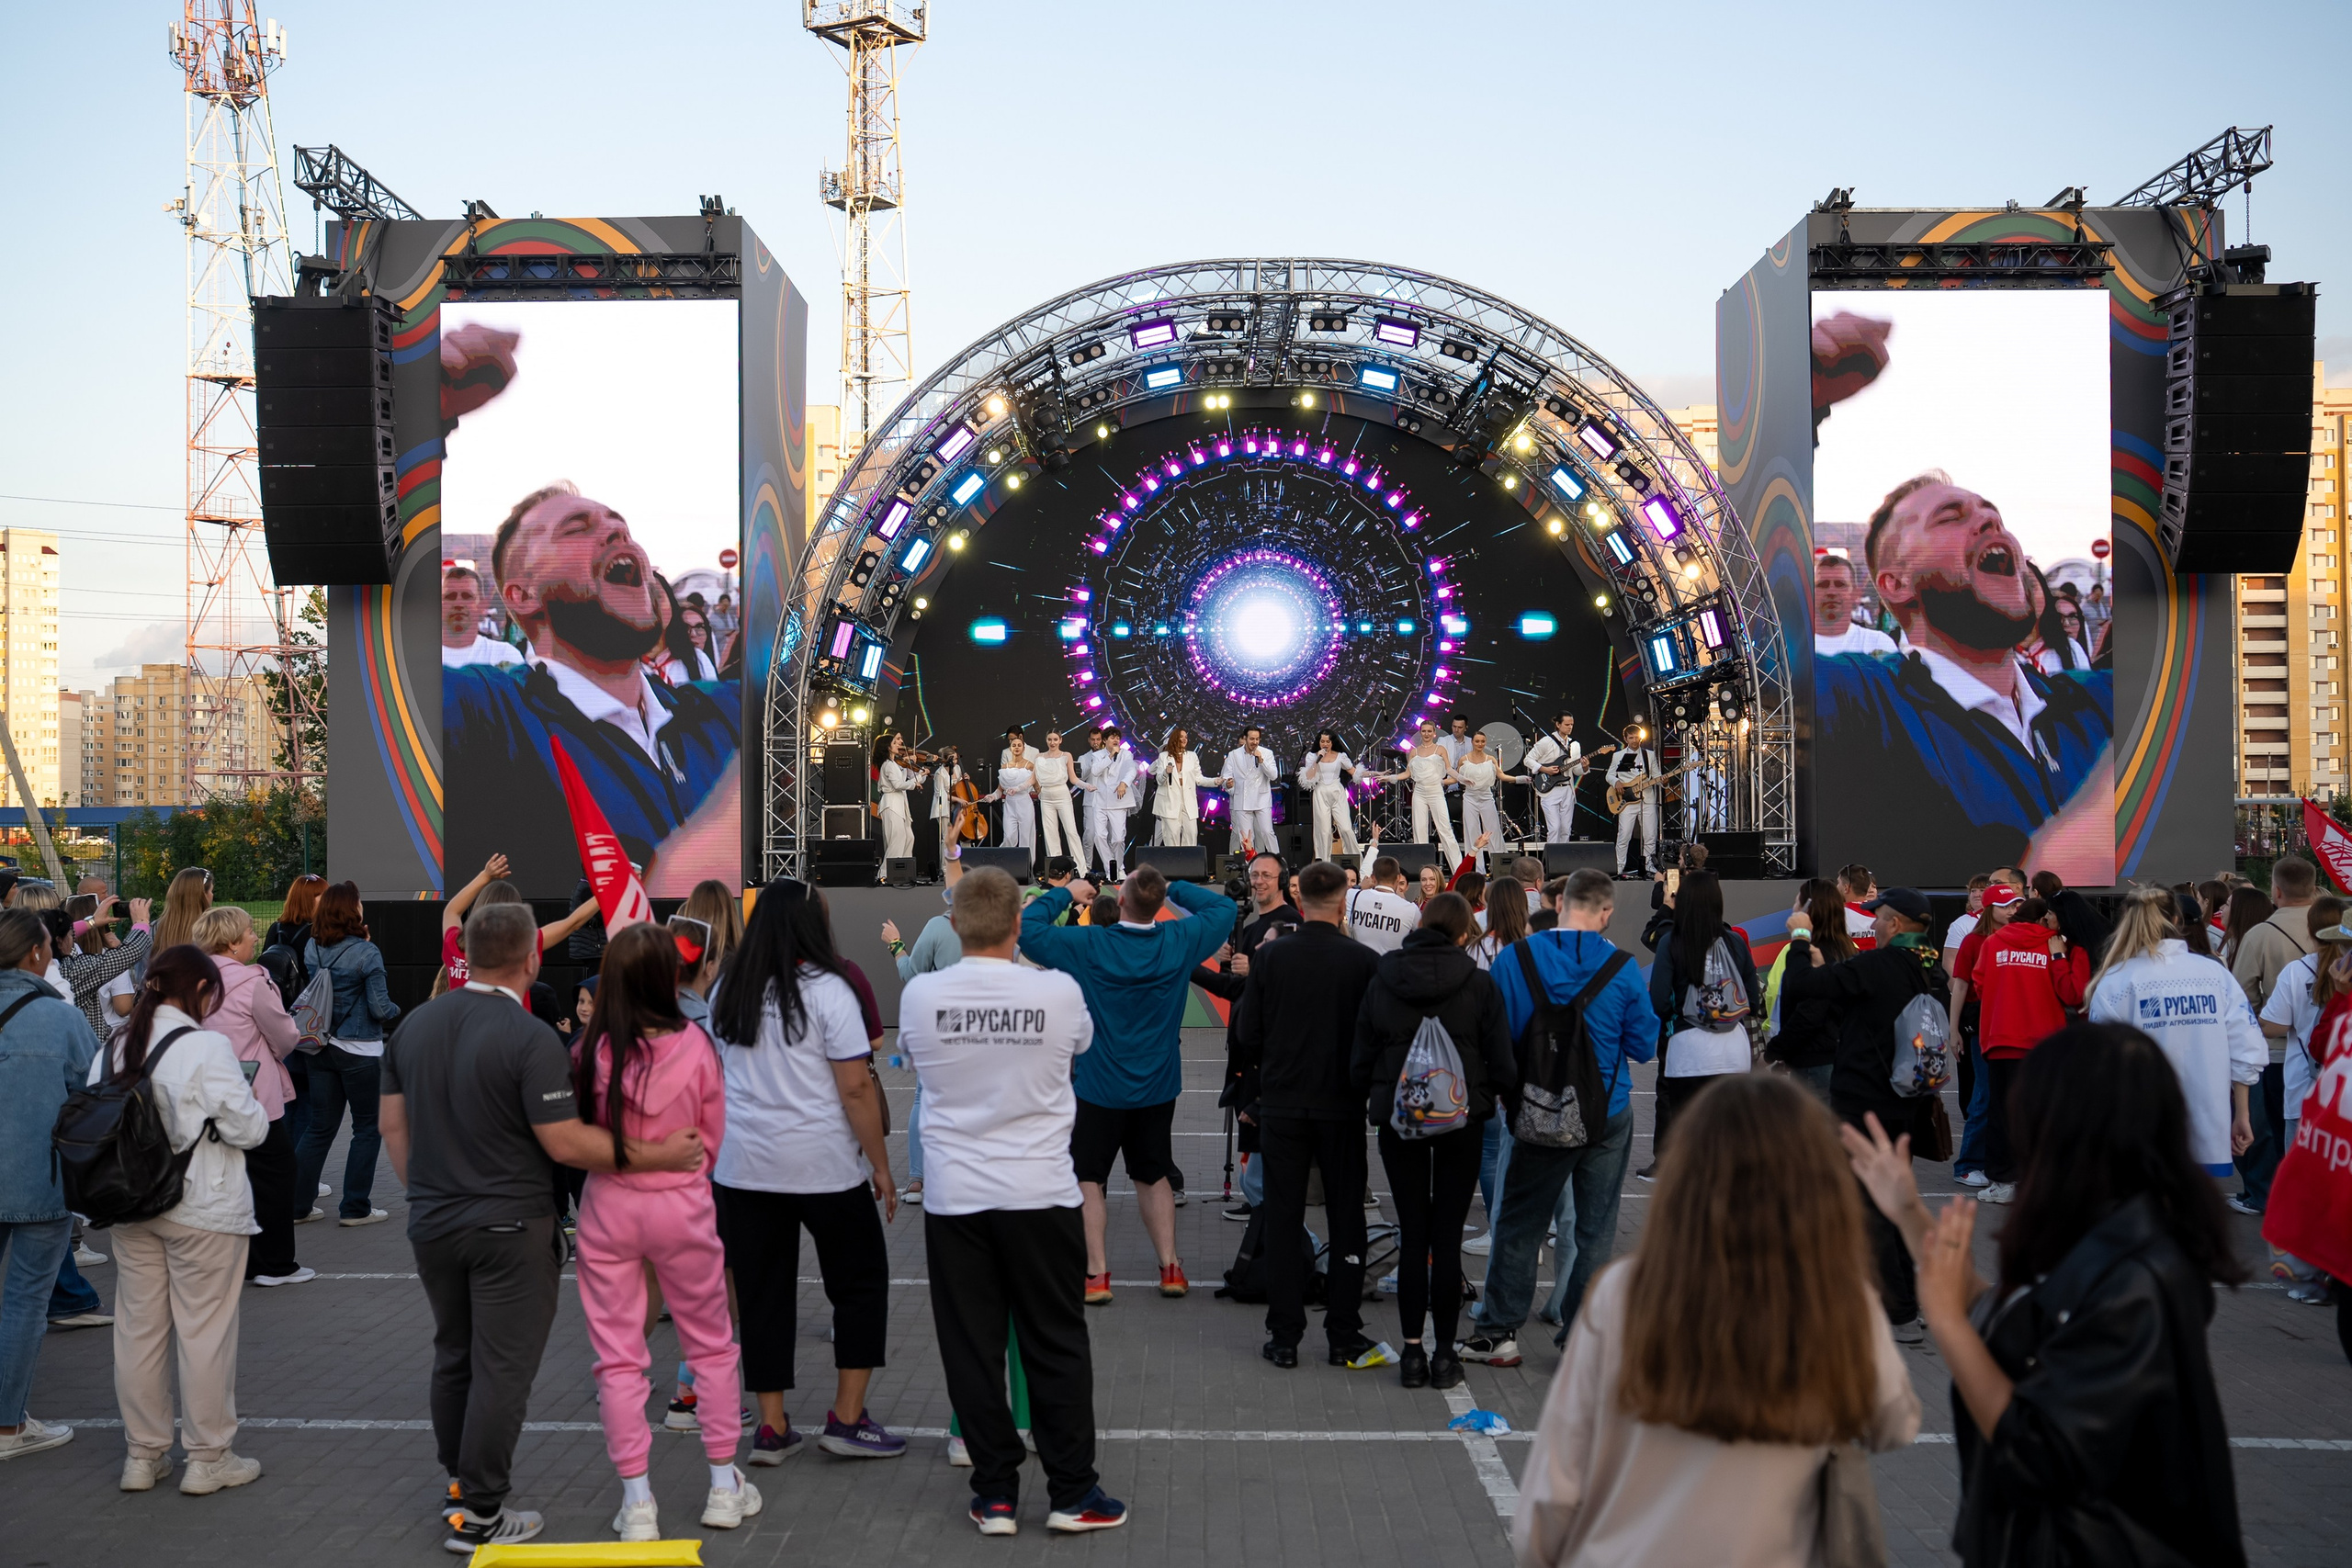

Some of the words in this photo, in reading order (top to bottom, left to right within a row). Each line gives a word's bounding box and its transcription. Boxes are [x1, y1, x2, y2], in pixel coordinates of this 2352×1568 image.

[1351, 910, 1401, 932] РУСАГРО
[2010, 951, 2047, 965] РУСАГРО
[2164, 995, 2217, 1016] РУСАГРО
[967, 1009, 1046, 1032] РУСАГРО
[2143, 1021, 2167, 1030] ЛИДЕР
[2169, 1018, 2218, 1027] АГРОБИЗНЕСА
[856, 1429, 881, 1442] HOKA
